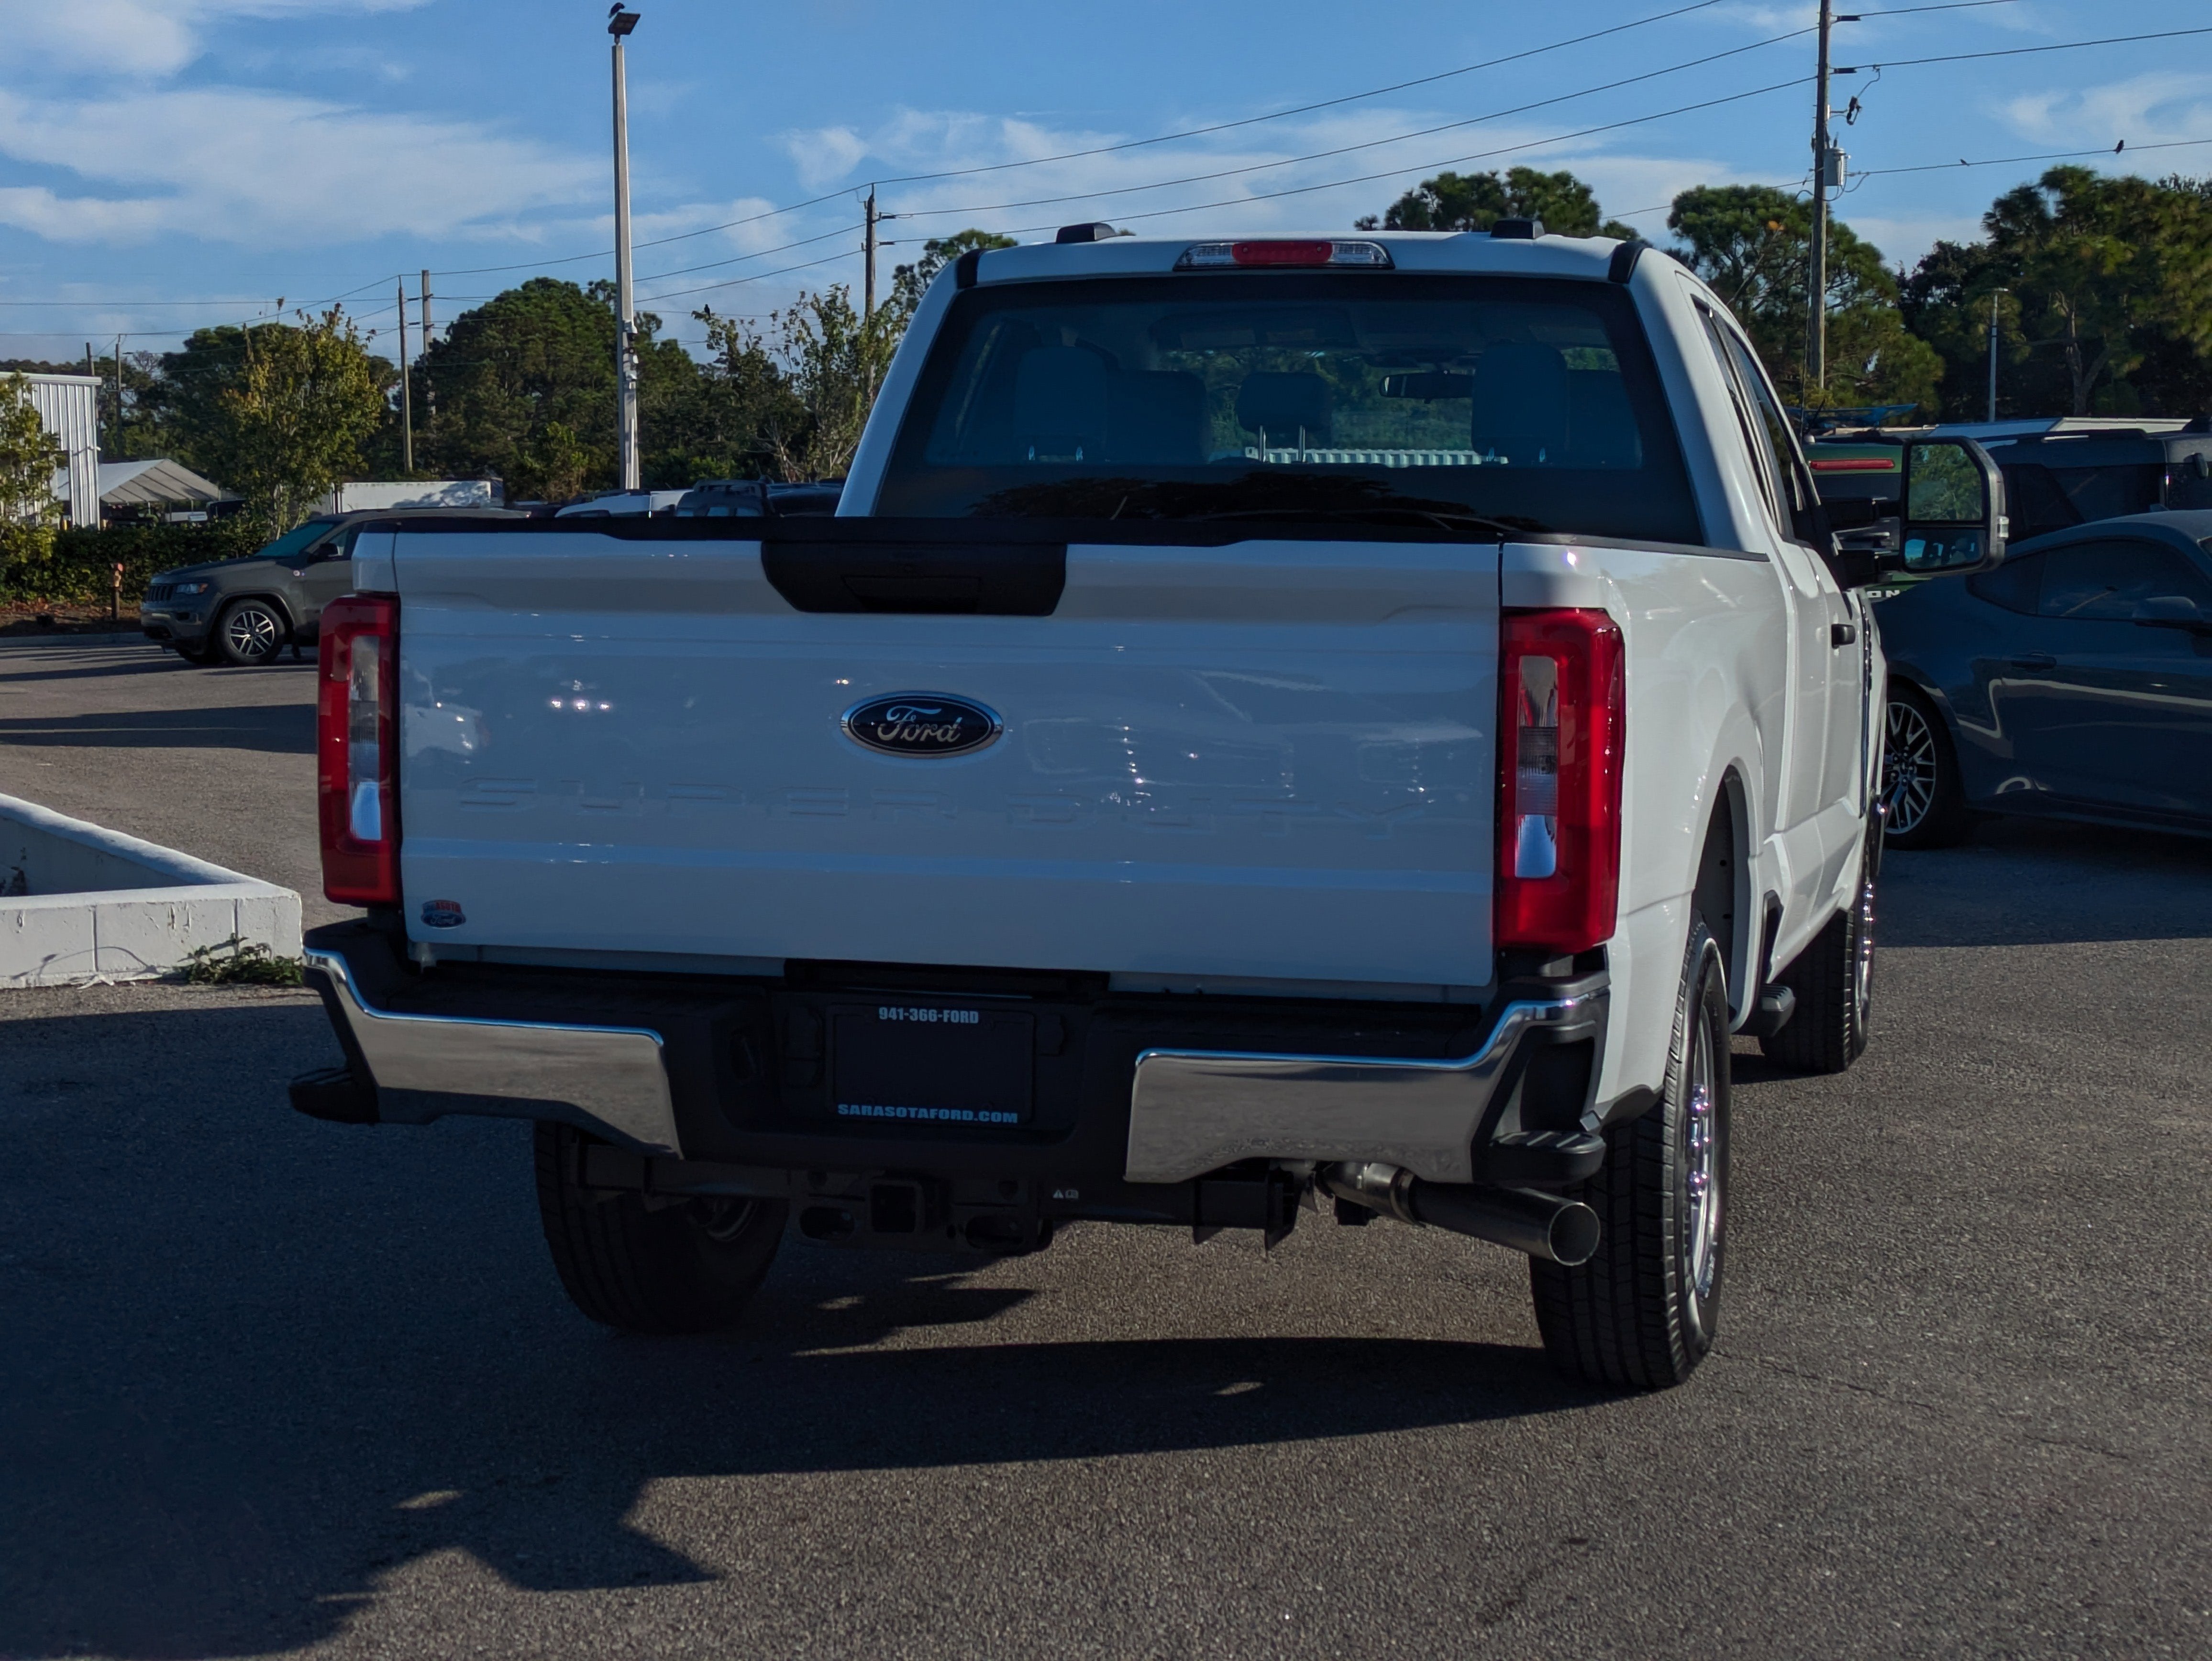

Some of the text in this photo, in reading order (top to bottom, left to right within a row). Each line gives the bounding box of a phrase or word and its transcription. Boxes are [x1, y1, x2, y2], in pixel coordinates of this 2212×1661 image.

[877, 706, 962, 743] Ford
[458, 777, 1427, 841] SUPER DUTY
[879, 1007, 979, 1024] 941-366-FORD
[838, 1104, 1018, 1123] SARASOTAFORD.COM
